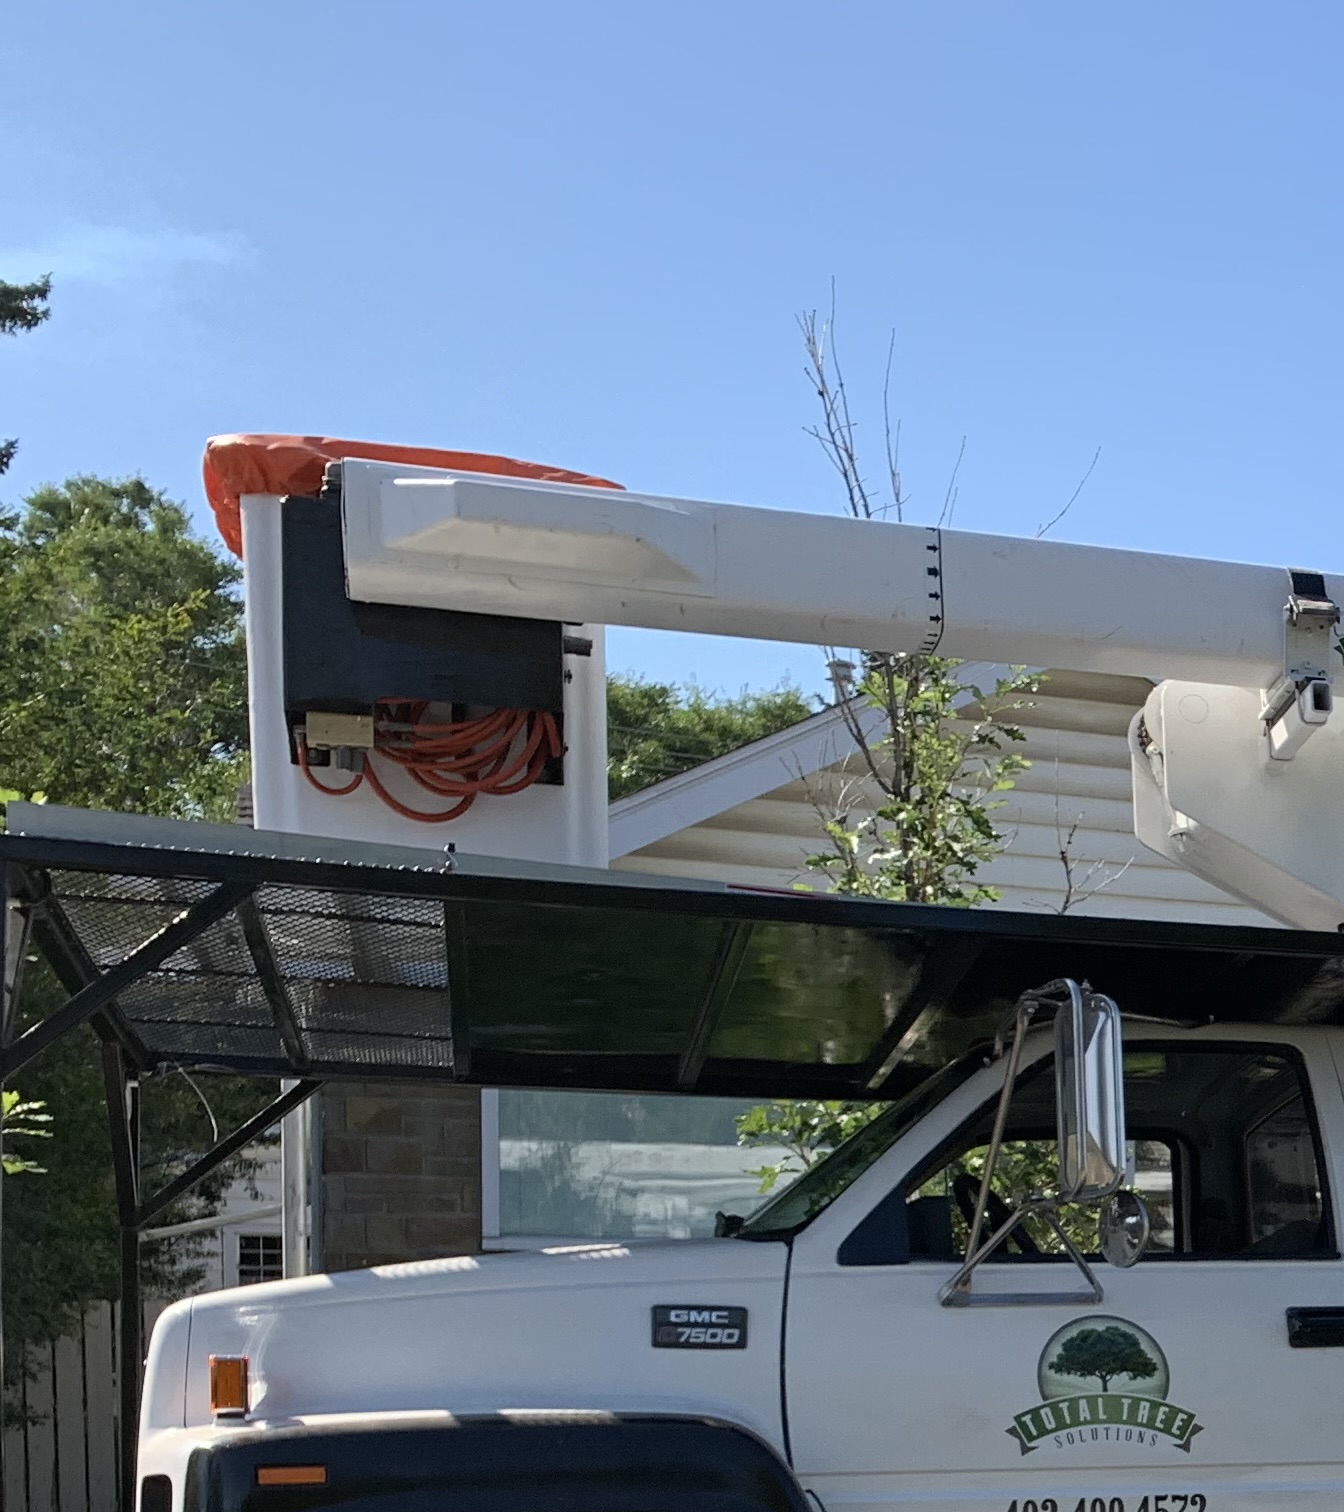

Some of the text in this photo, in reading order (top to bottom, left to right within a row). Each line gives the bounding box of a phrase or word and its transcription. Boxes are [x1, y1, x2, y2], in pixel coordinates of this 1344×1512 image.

[669, 1309, 729, 1323] GMC
[1021, 1397, 1189, 1436] TOTAL TREE
[1054, 1427, 1159, 1449] SOLUTIONS
